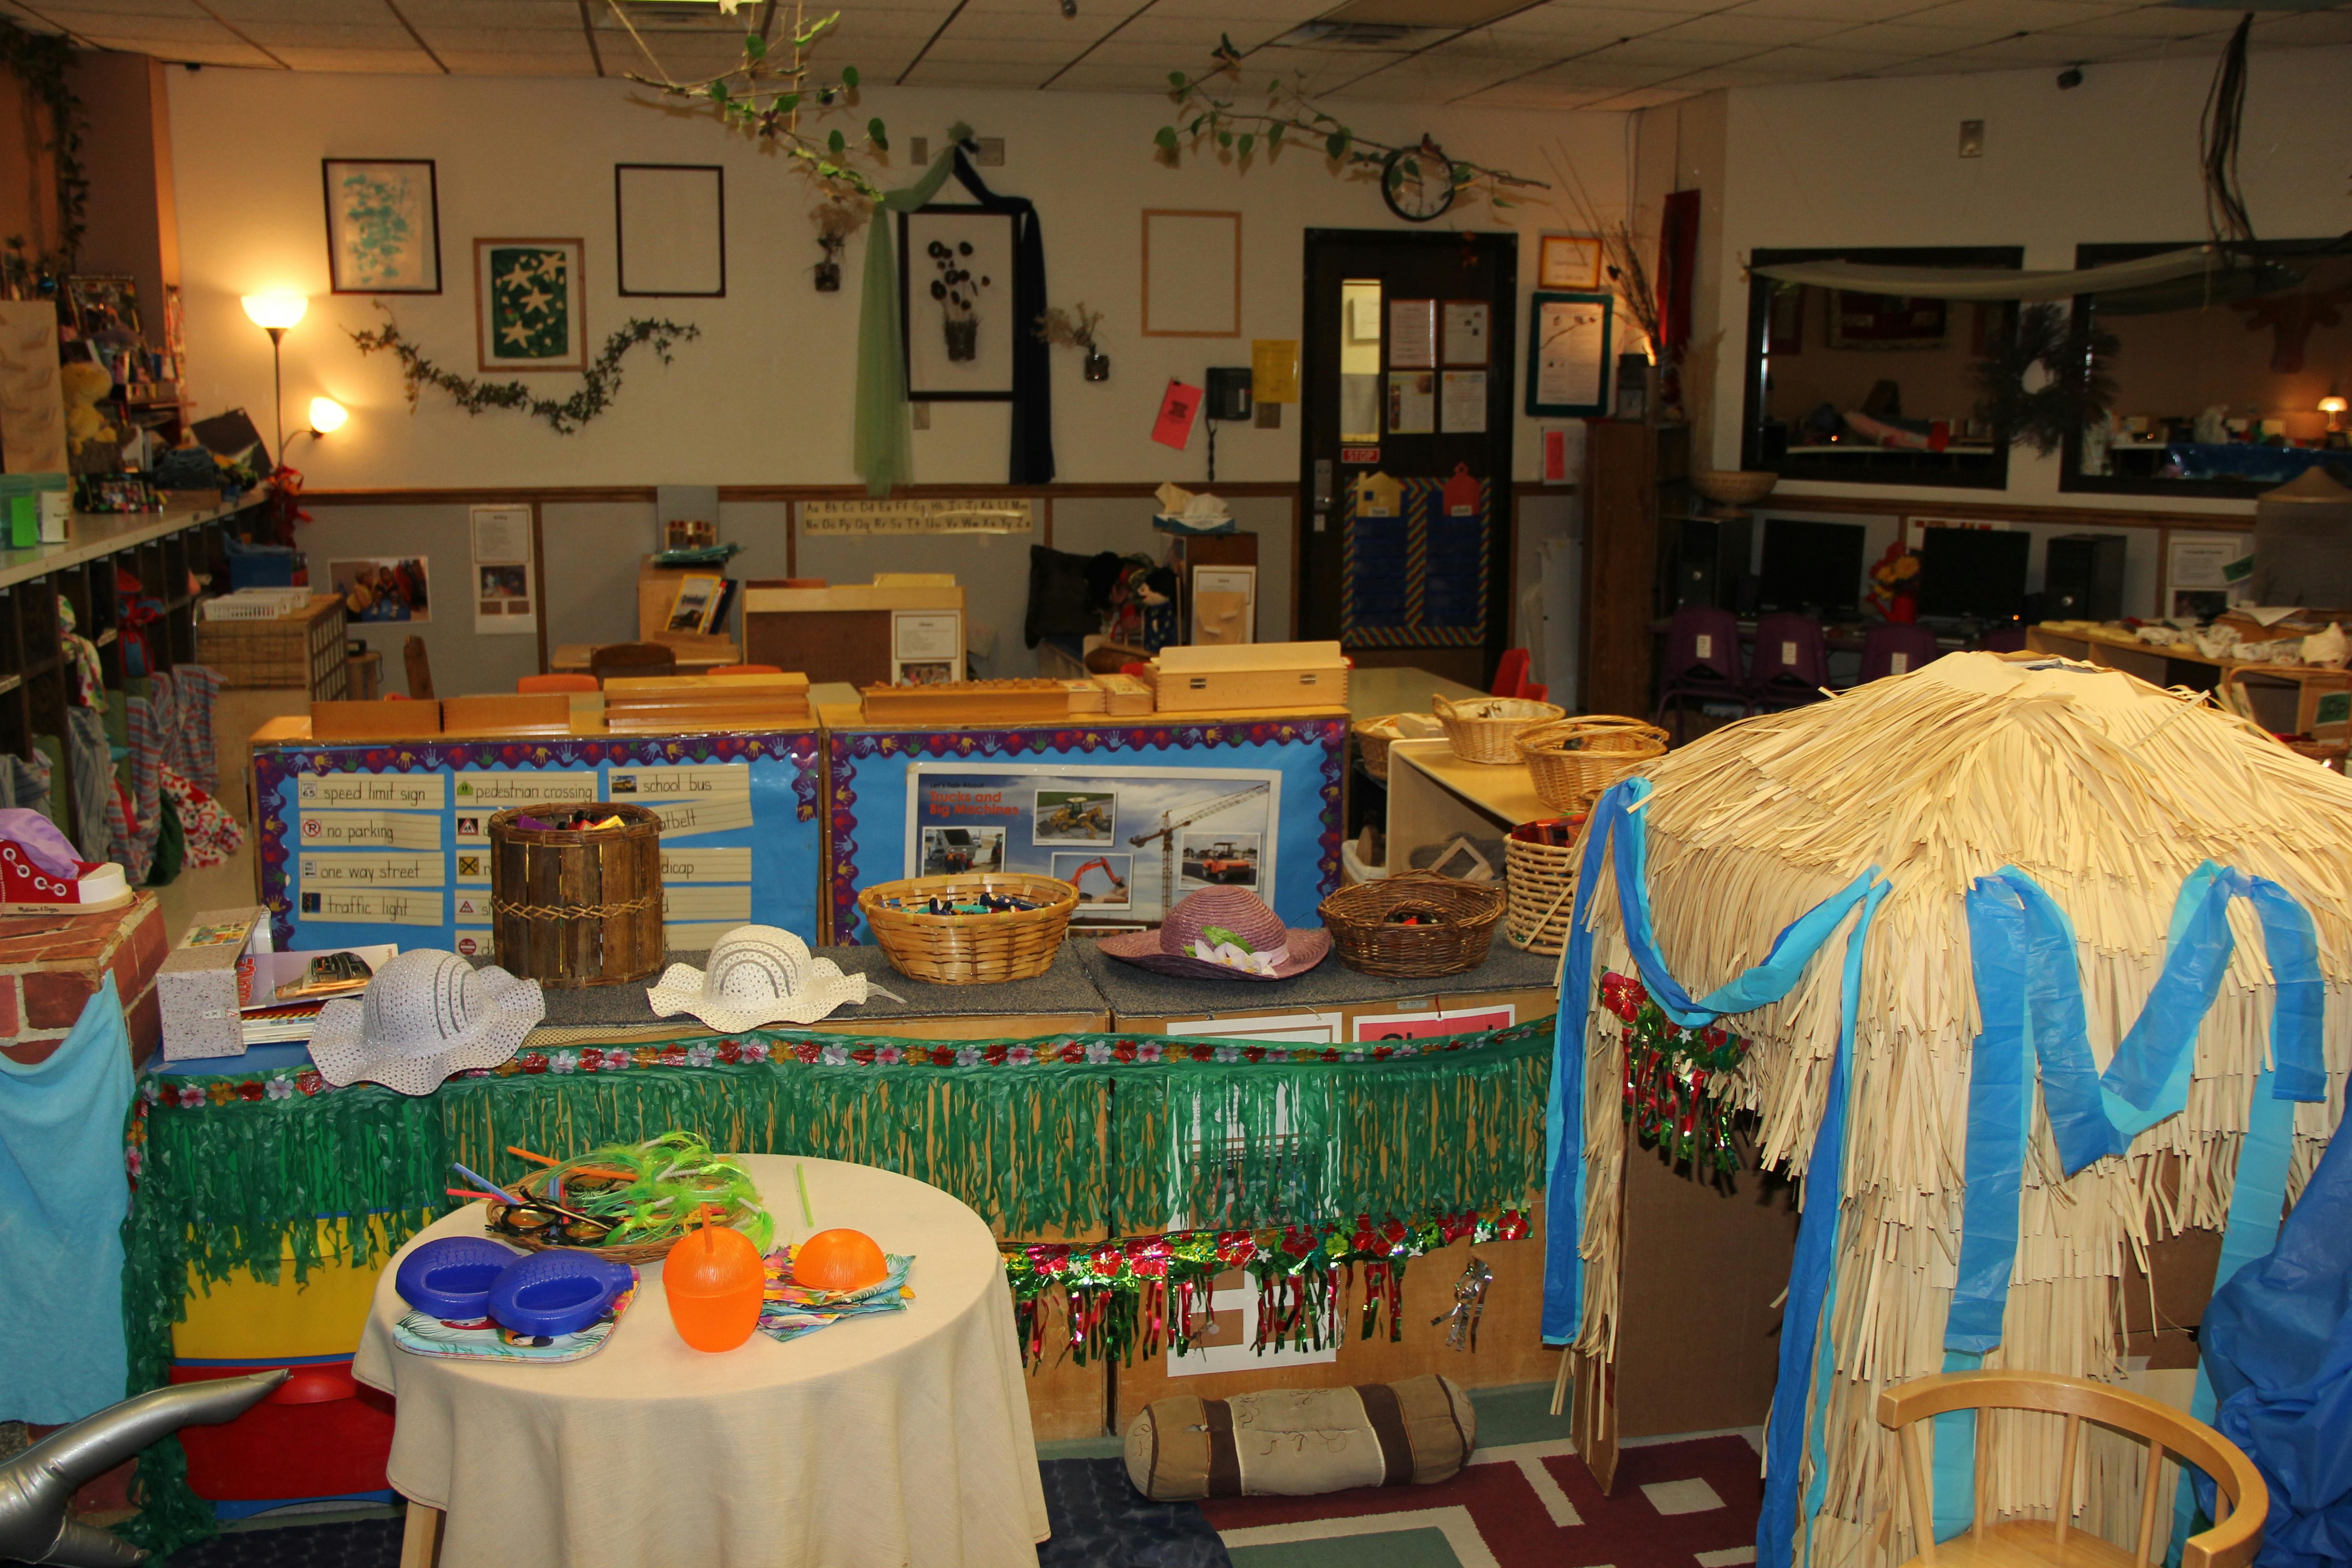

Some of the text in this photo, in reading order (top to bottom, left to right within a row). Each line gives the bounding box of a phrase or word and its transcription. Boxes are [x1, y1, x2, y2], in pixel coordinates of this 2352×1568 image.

[1347, 451, 1374, 462] STOP
[825, 501, 836, 513] Bb
[860, 501, 874, 512] Dd
[896, 501, 907, 511] Ff
[839, 519, 851, 533] Pp
[324, 781, 425, 806] speed limit sign
[476, 780, 593, 804] pedestrian crossing
[643, 773, 712, 793] school bus
[930, 790, 1002, 803] Trucks and
[661, 808, 697, 831] atbelt
[930, 804, 1019, 818] Big Machines
[327, 820, 393, 844] no parking
[321, 860, 420, 883] one way street
[661, 857, 695, 880] dicap
[327, 895, 408, 922] traffic light
